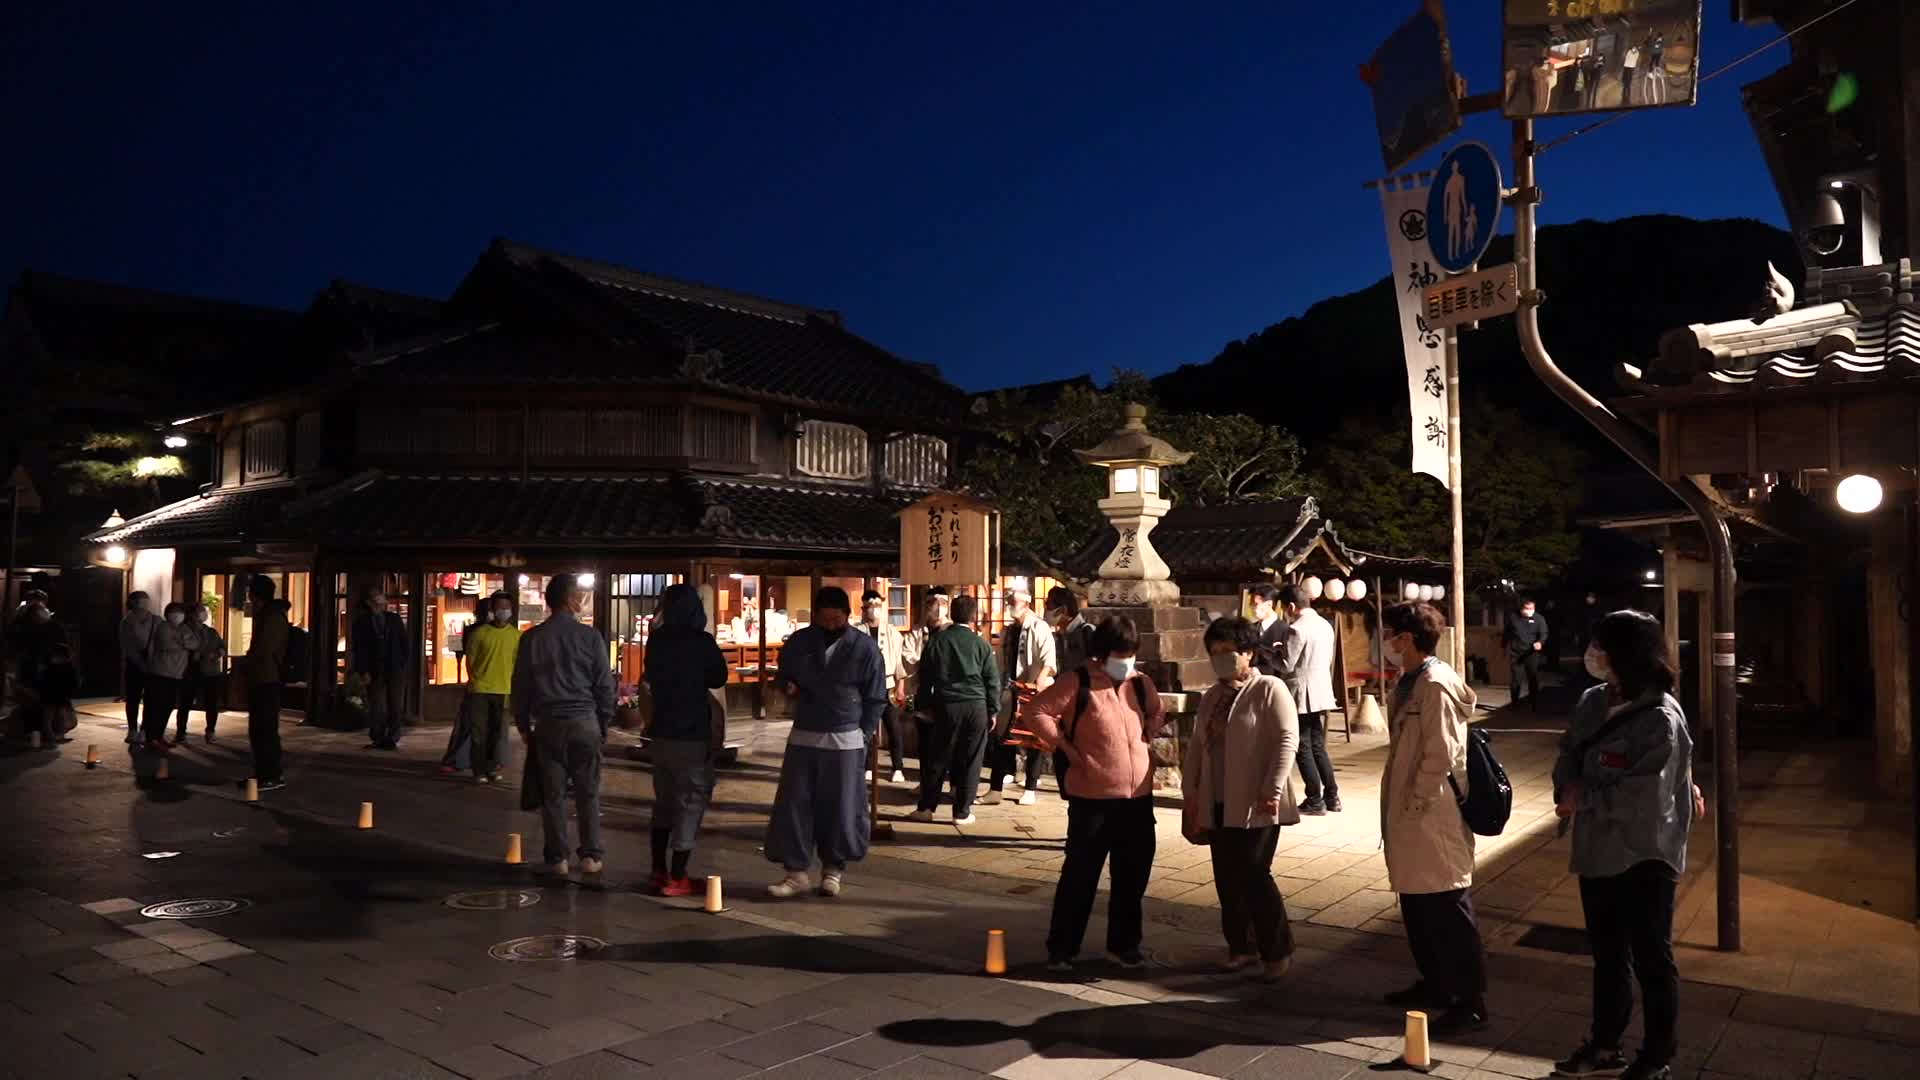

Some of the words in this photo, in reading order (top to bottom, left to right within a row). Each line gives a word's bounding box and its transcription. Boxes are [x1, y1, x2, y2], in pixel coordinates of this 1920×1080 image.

[1428, 280, 1507, 319] 自転車を除く
[928, 506, 944, 570] おかげ横丁
[949, 503, 960, 565] これより
